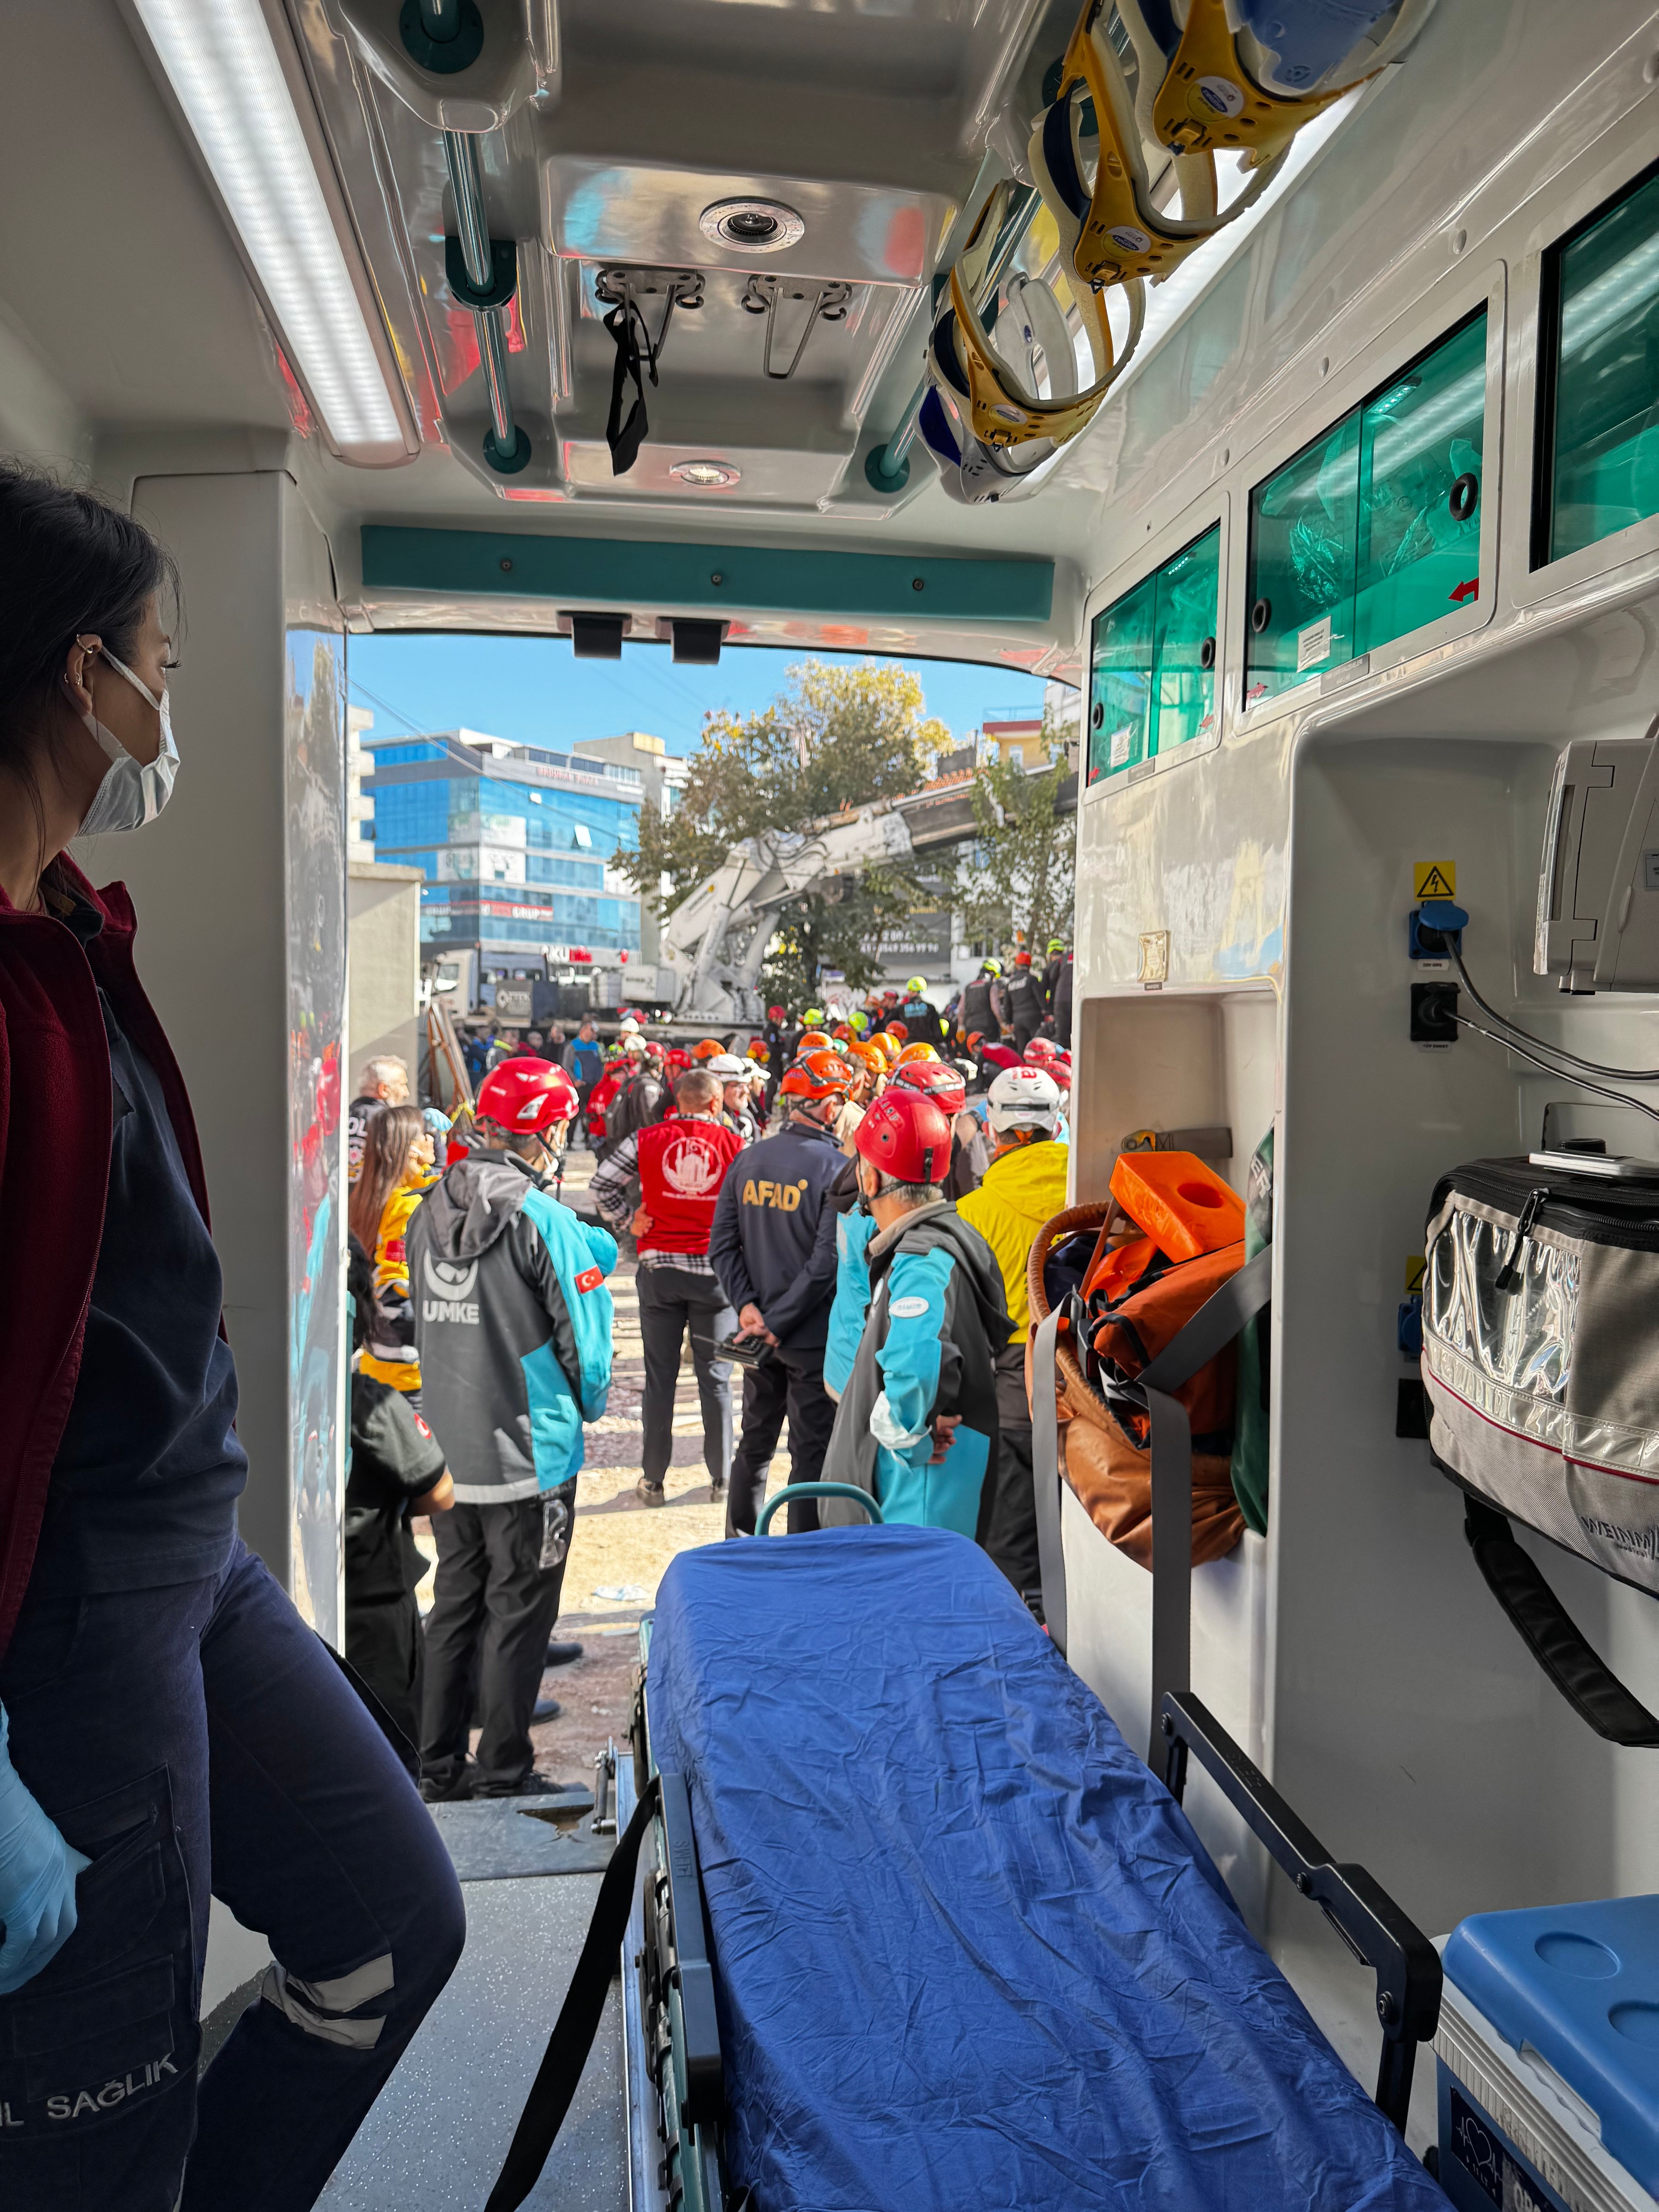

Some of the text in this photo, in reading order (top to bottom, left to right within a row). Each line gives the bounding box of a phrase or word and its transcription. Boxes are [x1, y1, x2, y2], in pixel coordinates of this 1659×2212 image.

[742, 1179, 801, 1212] AFAD
[422, 1300, 480, 1325] UMKE
[47, 2052, 179, 2119] SAĞLIK
